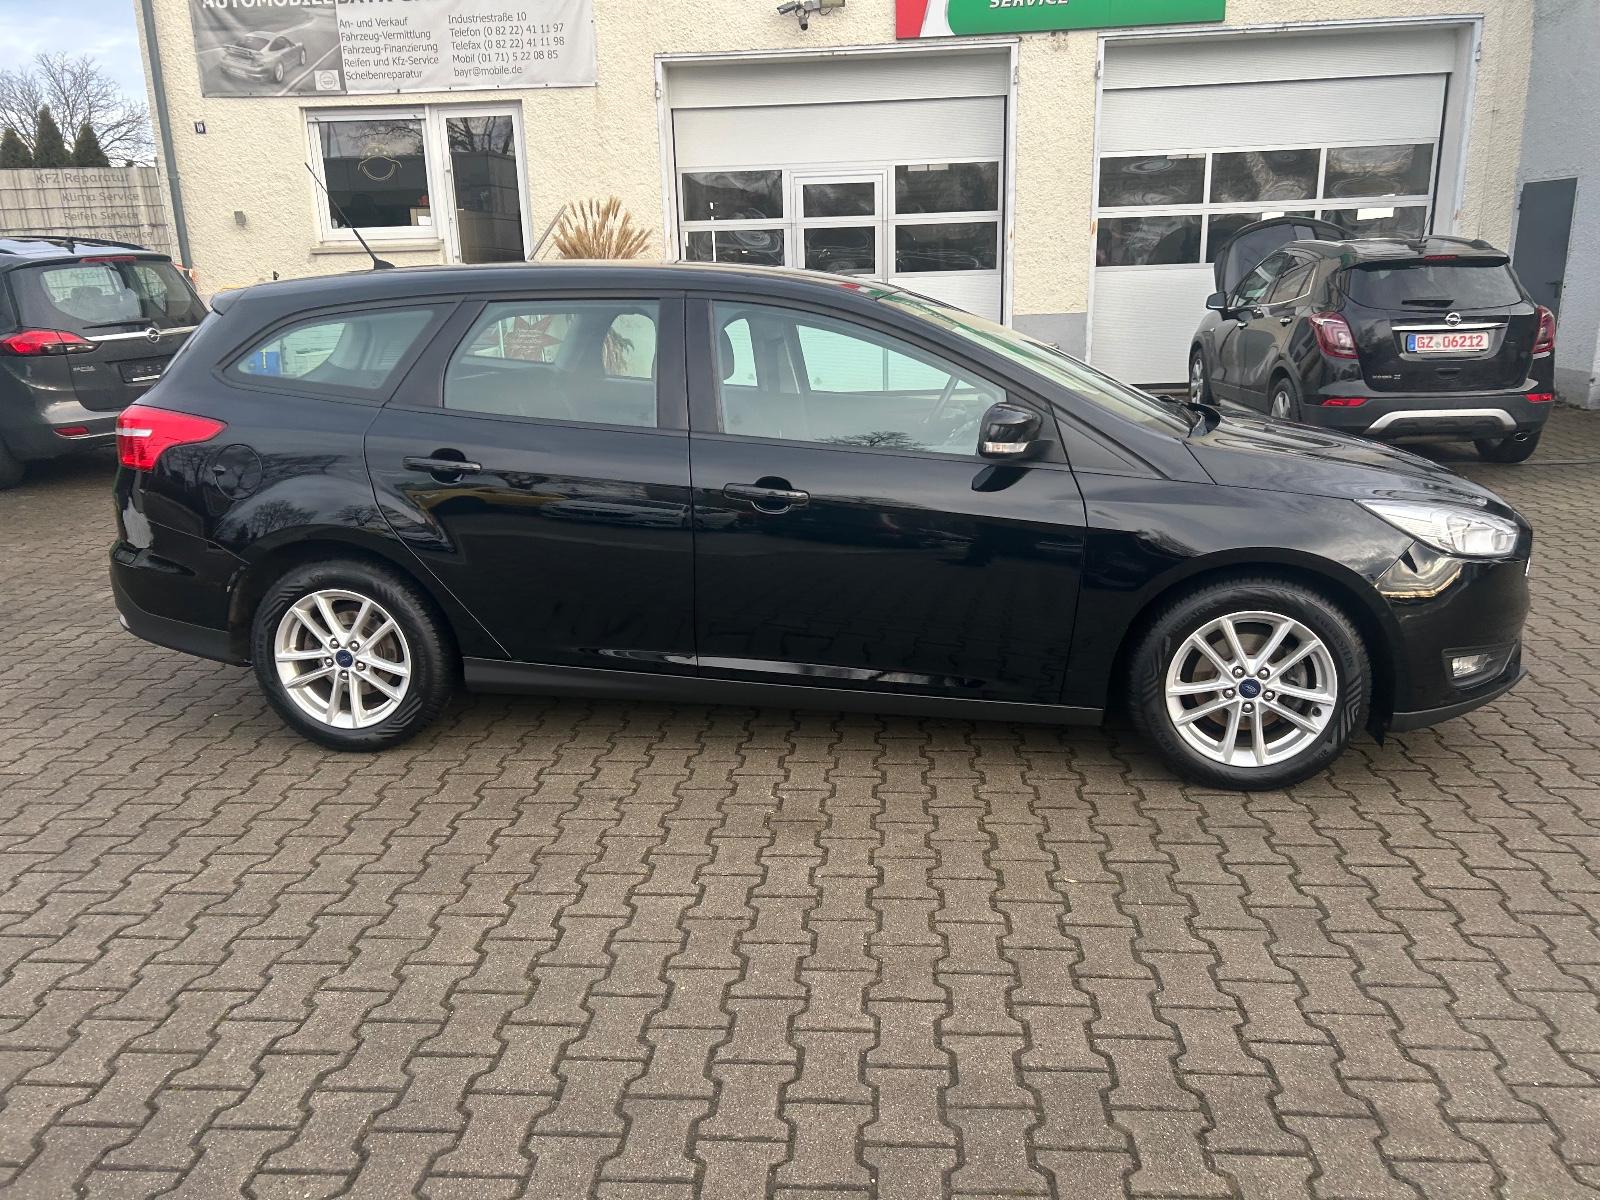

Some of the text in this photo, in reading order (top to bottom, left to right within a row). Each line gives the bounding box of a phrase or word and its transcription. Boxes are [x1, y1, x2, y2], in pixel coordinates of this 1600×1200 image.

[340, 17, 408, 28] An- und Verkauf
[448, 12, 527, 24] Industriestraße 10
[341, 30, 431, 42] Fahrzeug-Vermittlung
[449, 23, 564, 38] Telefon (0 82 22) 41 11 97
[342, 43, 439, 56] Fahrzeug-Finanzierung
[451, 36, 565, 51] Telefax (0 82 22) 41 11 98
[344, 56, 439, 68] Reifen und Kfz-Service
[452, 50, 558, 64] Mobil (01 71) 5 22 08 85
[346, 70, 422, 80] Scheibenreparatur
[454, 65, 522, 78] bayr@mobile.de
[36, 172, 130, 185] KFZ Reparatur
[62, 192, 140, 202] Klima Service
[64, 211, 138, 221] Reifen Service
[117, 230, 152, 239] Service
[1417, 335, 1484, 349] GZ 06212
